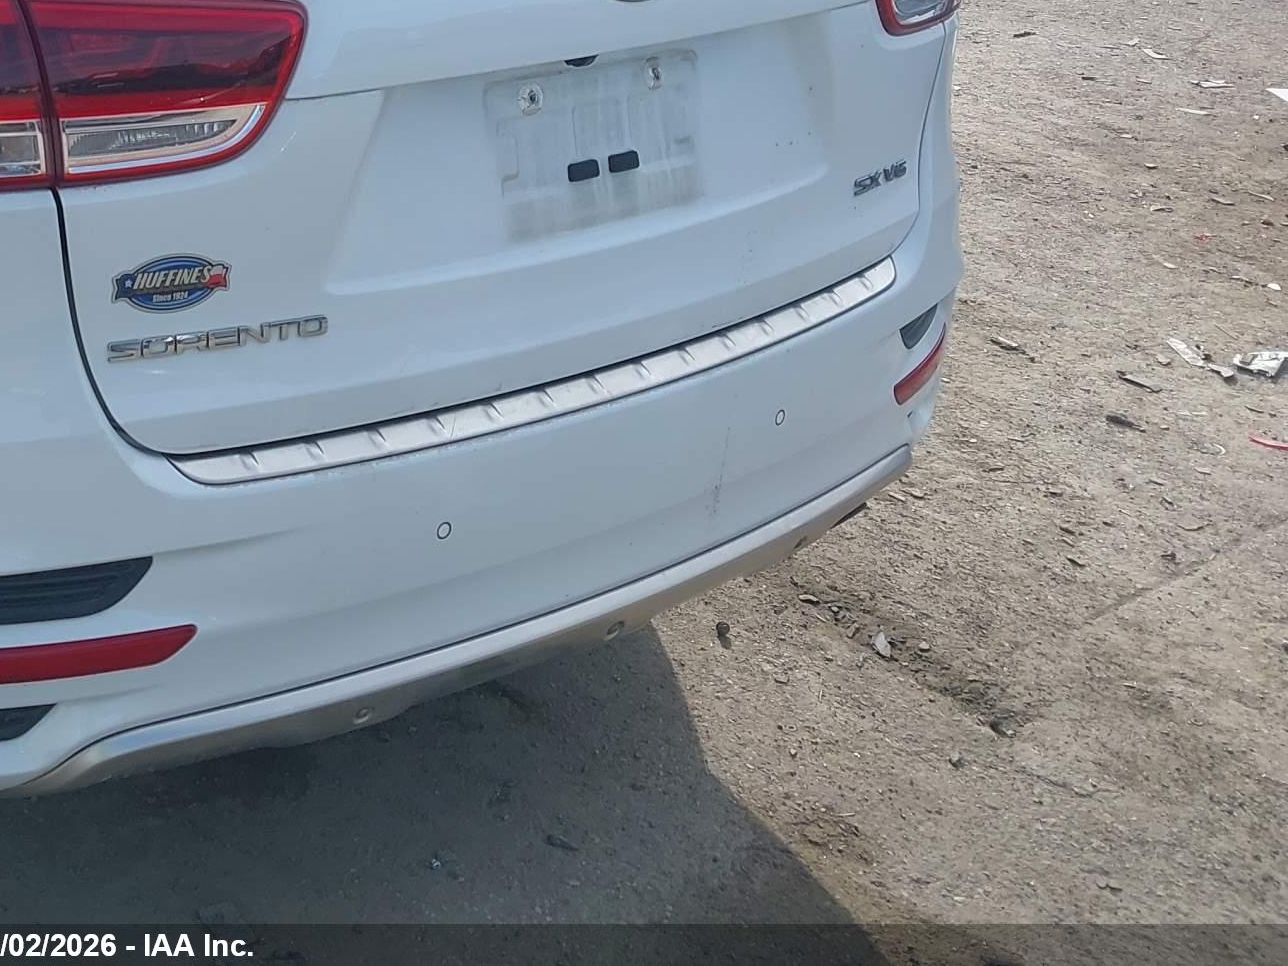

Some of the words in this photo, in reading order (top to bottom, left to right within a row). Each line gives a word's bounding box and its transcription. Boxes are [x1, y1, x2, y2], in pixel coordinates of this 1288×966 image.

[854, 170, 882, 196] SX
[883, 159, 907, 183] V6
[133, 265, 212, 290] HUFFINES
[152, 294, 172, 303] Since
[108, 314, 328, 363] SORENTO
